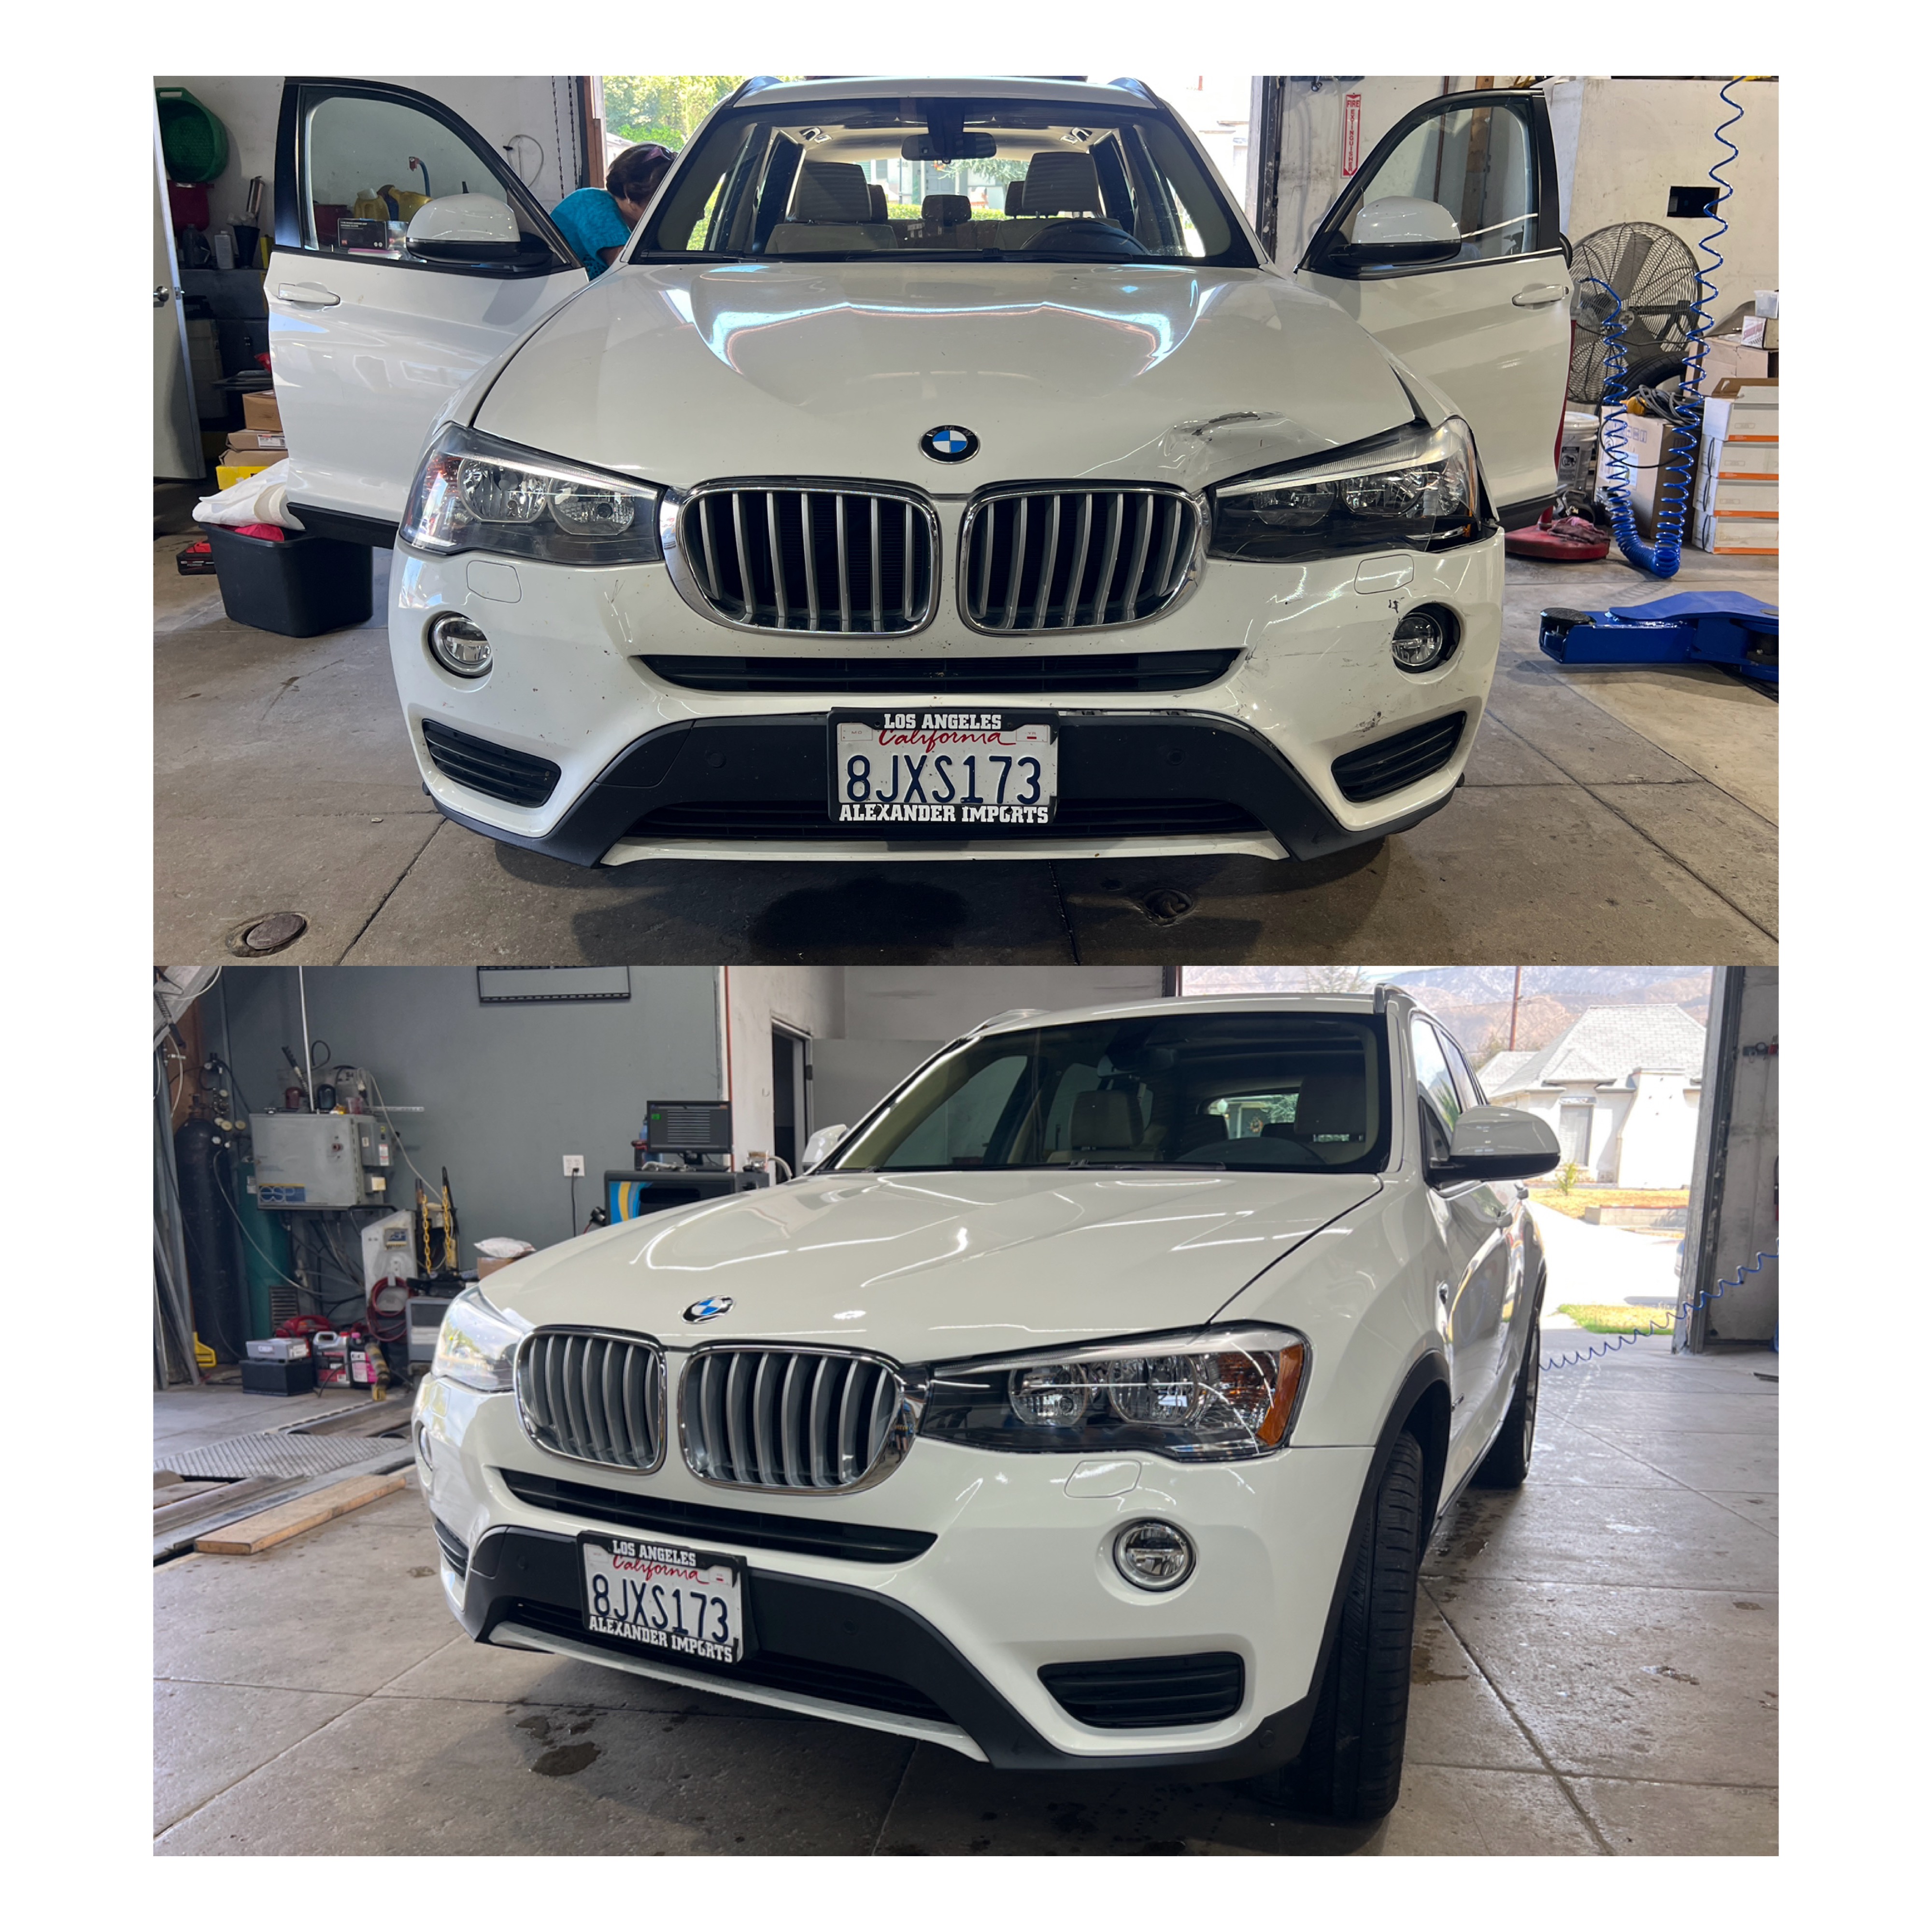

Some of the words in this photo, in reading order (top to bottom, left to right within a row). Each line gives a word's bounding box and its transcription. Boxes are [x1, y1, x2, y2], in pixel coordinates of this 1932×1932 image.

[884, 713, 915, 729] LOS
[922, 714, 1002, 730] ANGELES
[879, 729, 1016, 753] California
[847, 755, 1041, 804] 8JXS173
[839, 805, 956, 822] ALEXANDER
[612, 1540, 635, 1556] LOS
[639, 1546, 696, 1566] ANGELES
[612, 1555, 710, 1584] California
[592, 1573, 729, 1643] 8JXS173
[589, 1615, 668, 1648] ALEXANDER
